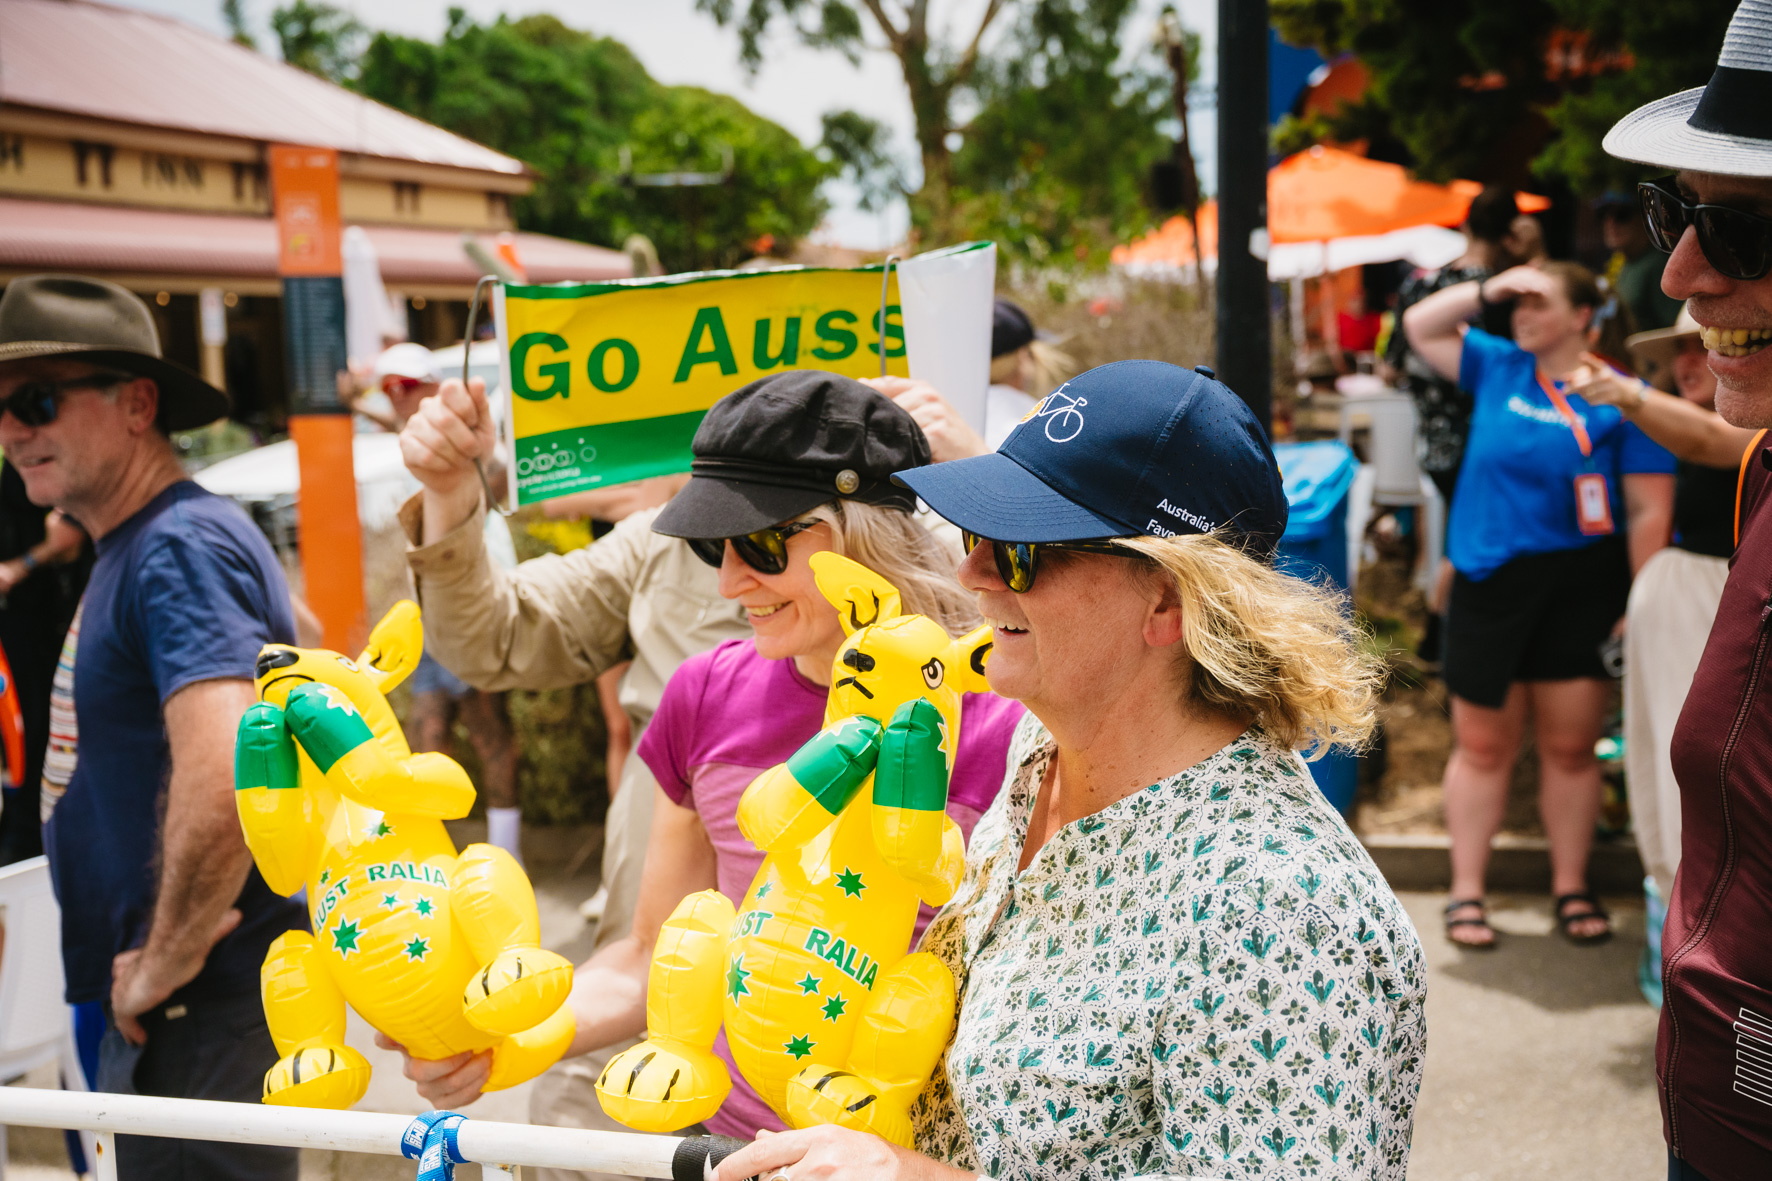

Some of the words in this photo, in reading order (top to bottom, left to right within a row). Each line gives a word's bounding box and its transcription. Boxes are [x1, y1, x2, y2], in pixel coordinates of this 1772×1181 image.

[510, 332, 640, 401] Go
[1146, 518, 1180, 539] Favo
[368, 863, 448, 888] RALIA
[804, 927, 879, 992] RALIA
